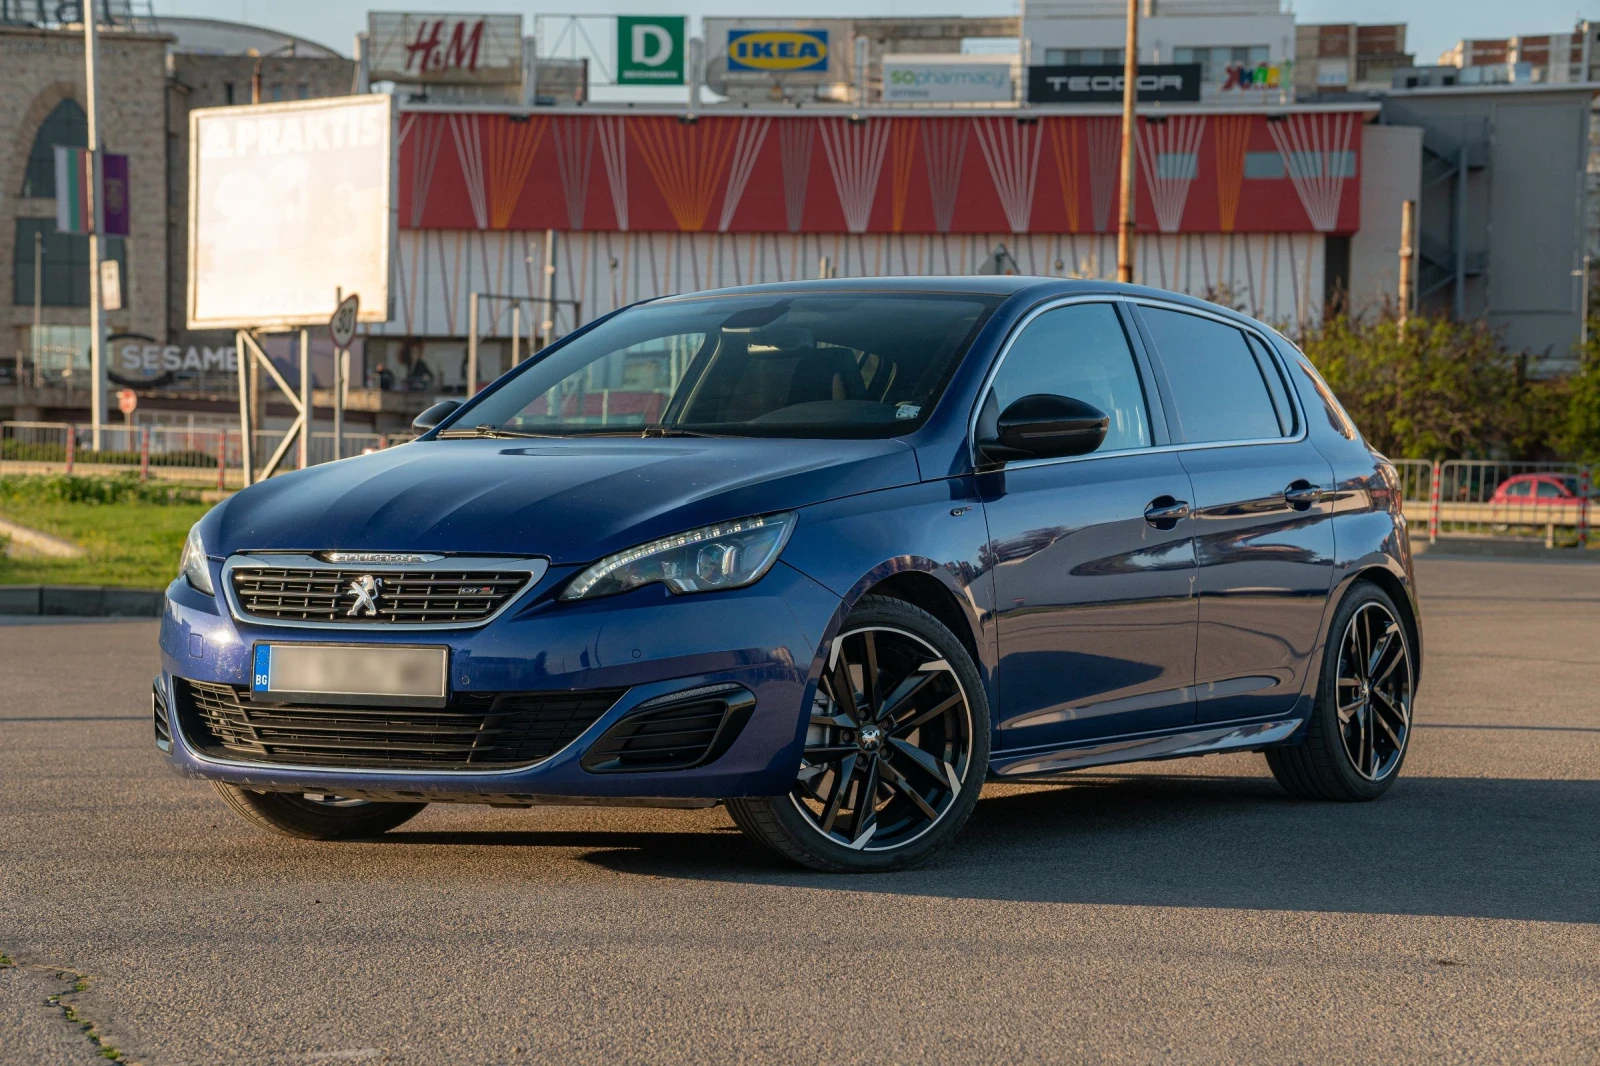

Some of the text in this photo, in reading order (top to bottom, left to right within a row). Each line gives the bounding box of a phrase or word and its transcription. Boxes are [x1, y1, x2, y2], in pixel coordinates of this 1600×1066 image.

[405, 20, 484, 73] H&M
[631, 24, 673, 67] D
[737, 42, 819, 59] IKEA
[235, 107, 382, 157] PRAKTIS
[121, 344, 238, 371] SESAME
[255, 674, 268, 686] BG
